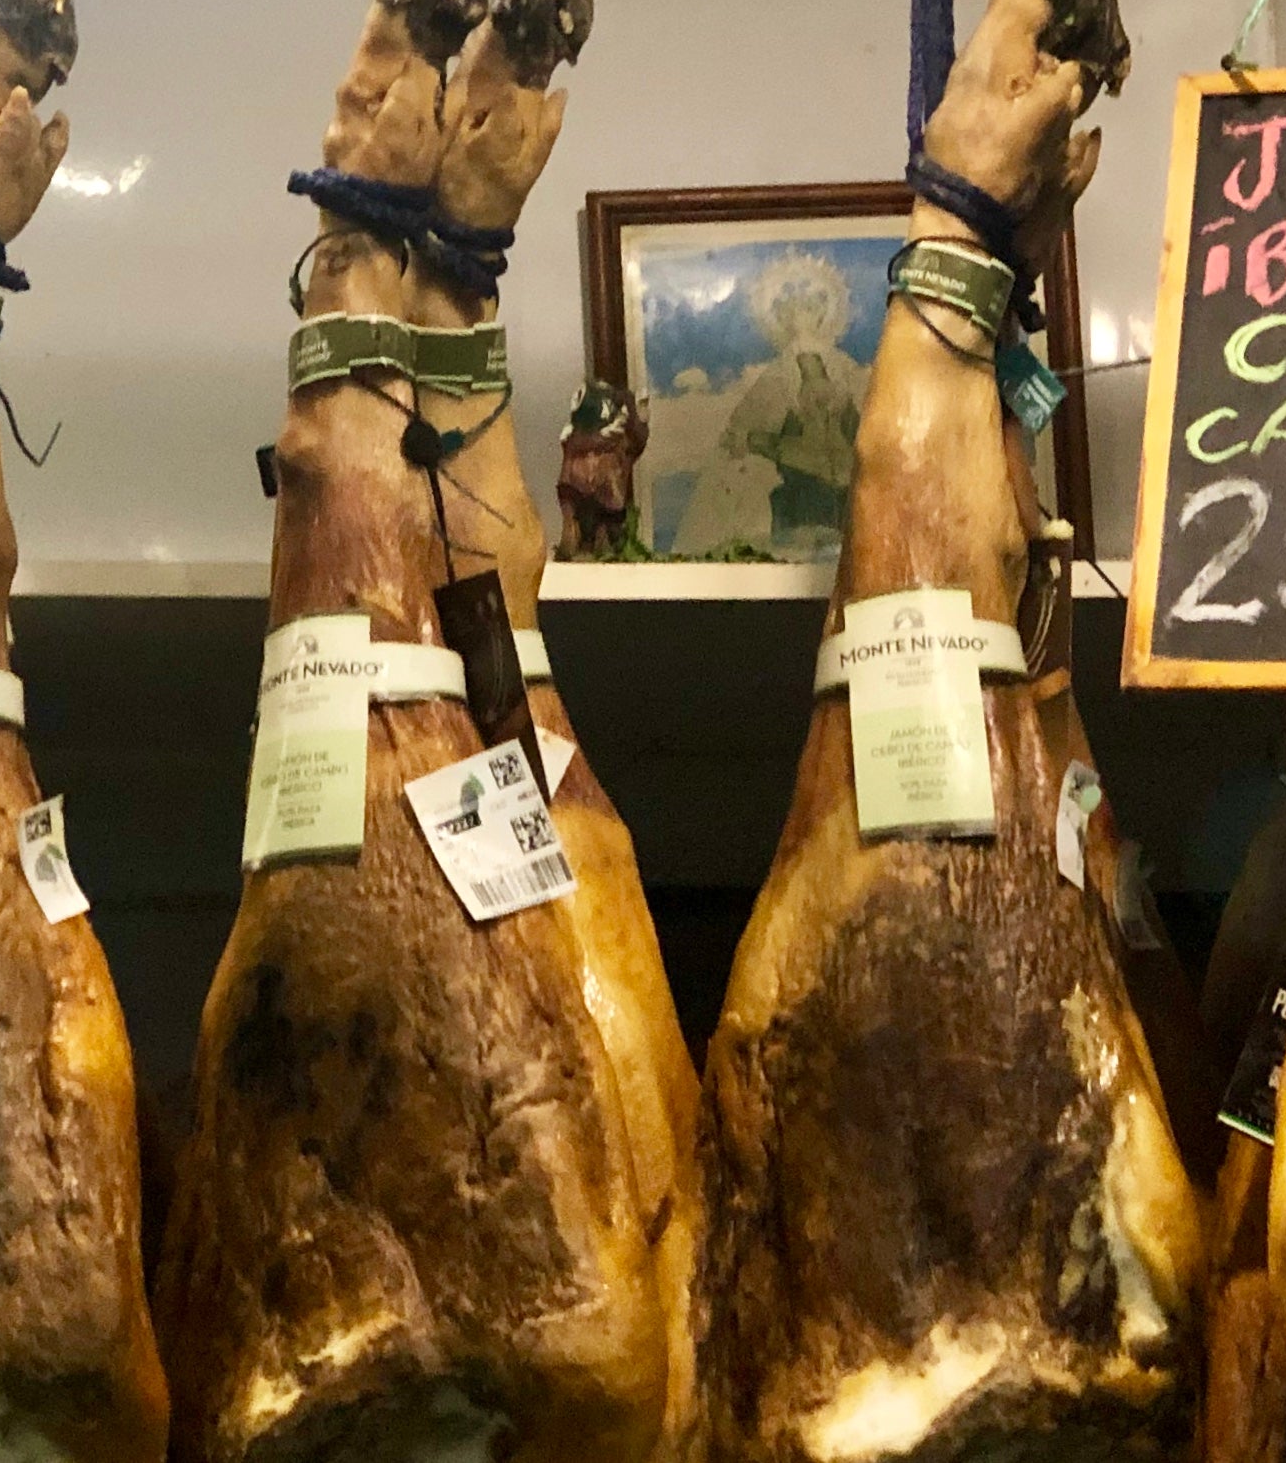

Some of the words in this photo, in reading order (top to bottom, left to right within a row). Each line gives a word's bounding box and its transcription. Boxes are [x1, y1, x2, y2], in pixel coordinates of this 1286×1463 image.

[840, 639, 909, 670] MONTE
[261, 668, 298, 693] ONTE
[303, 660, 380, 680] NEVADO
